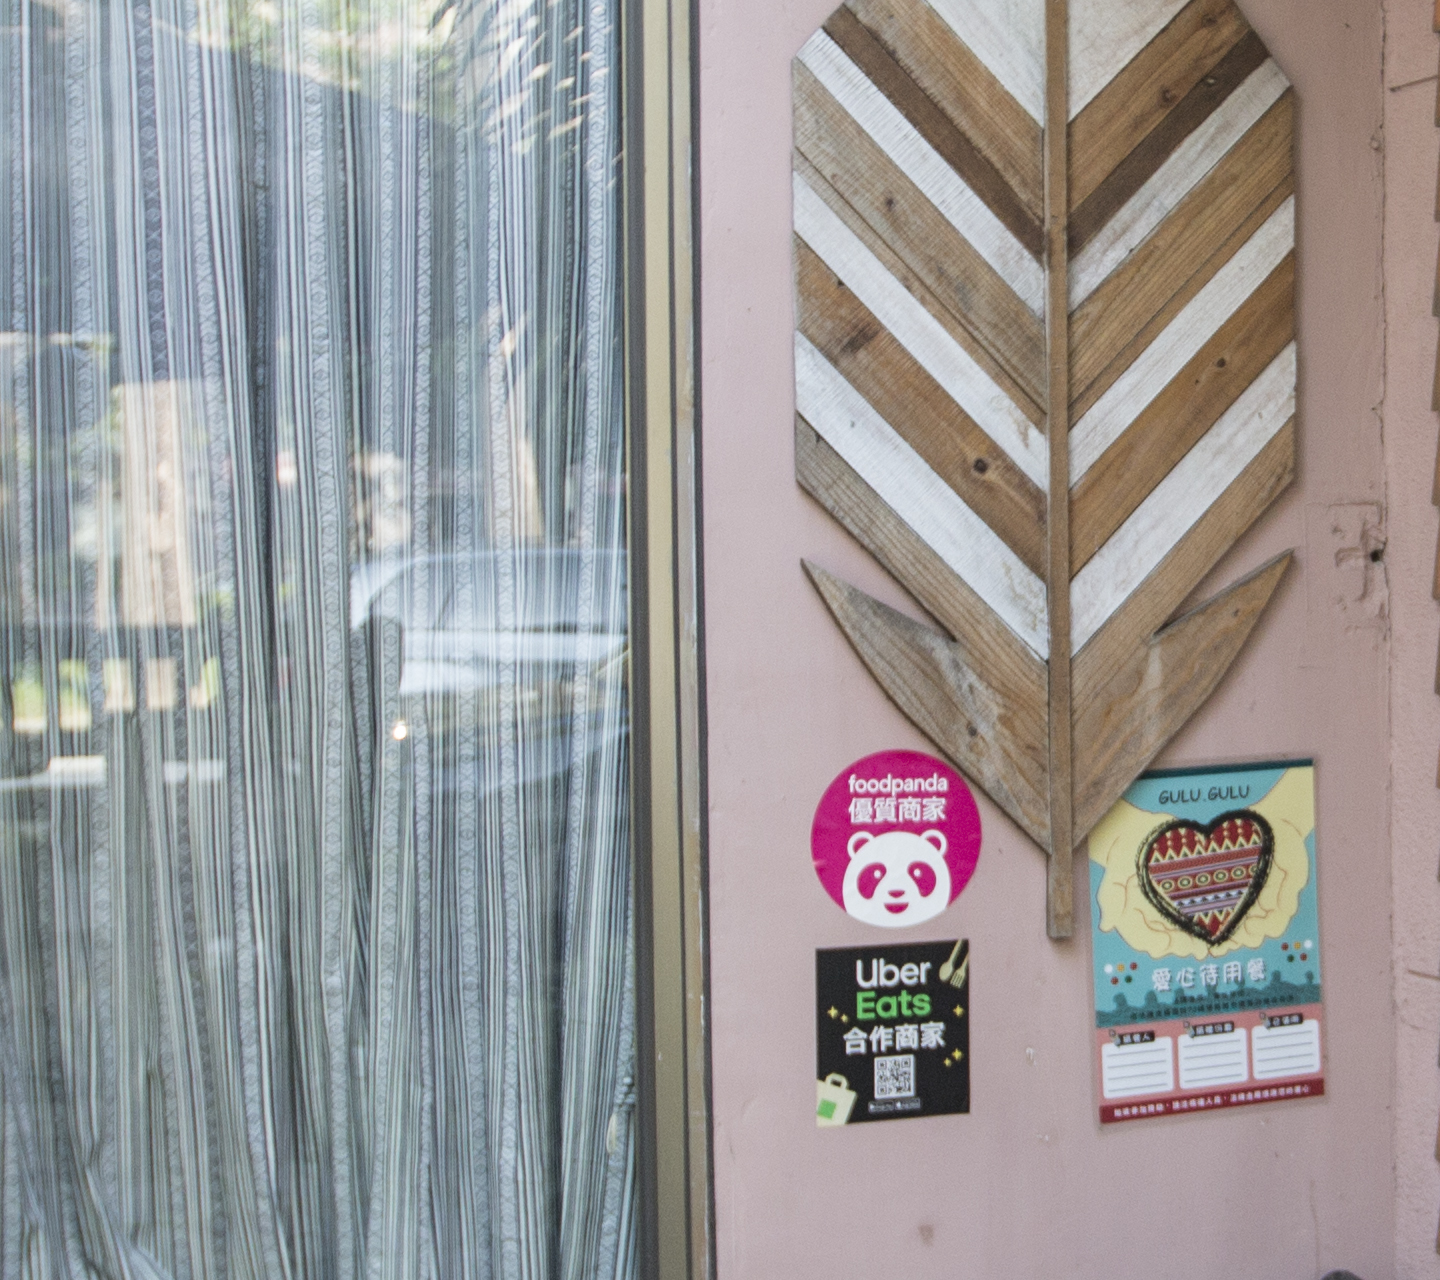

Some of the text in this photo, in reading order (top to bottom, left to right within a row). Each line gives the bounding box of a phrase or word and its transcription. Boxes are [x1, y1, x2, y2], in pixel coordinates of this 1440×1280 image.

[848, 773, 948, 797] foodpanda
[848, 795, 946, 823] 優質商家
[855, 958, 932, 988] Uber
[856, 989, 932, 1020] Eats
[843, 1021, 946, 1055] 合作商家
